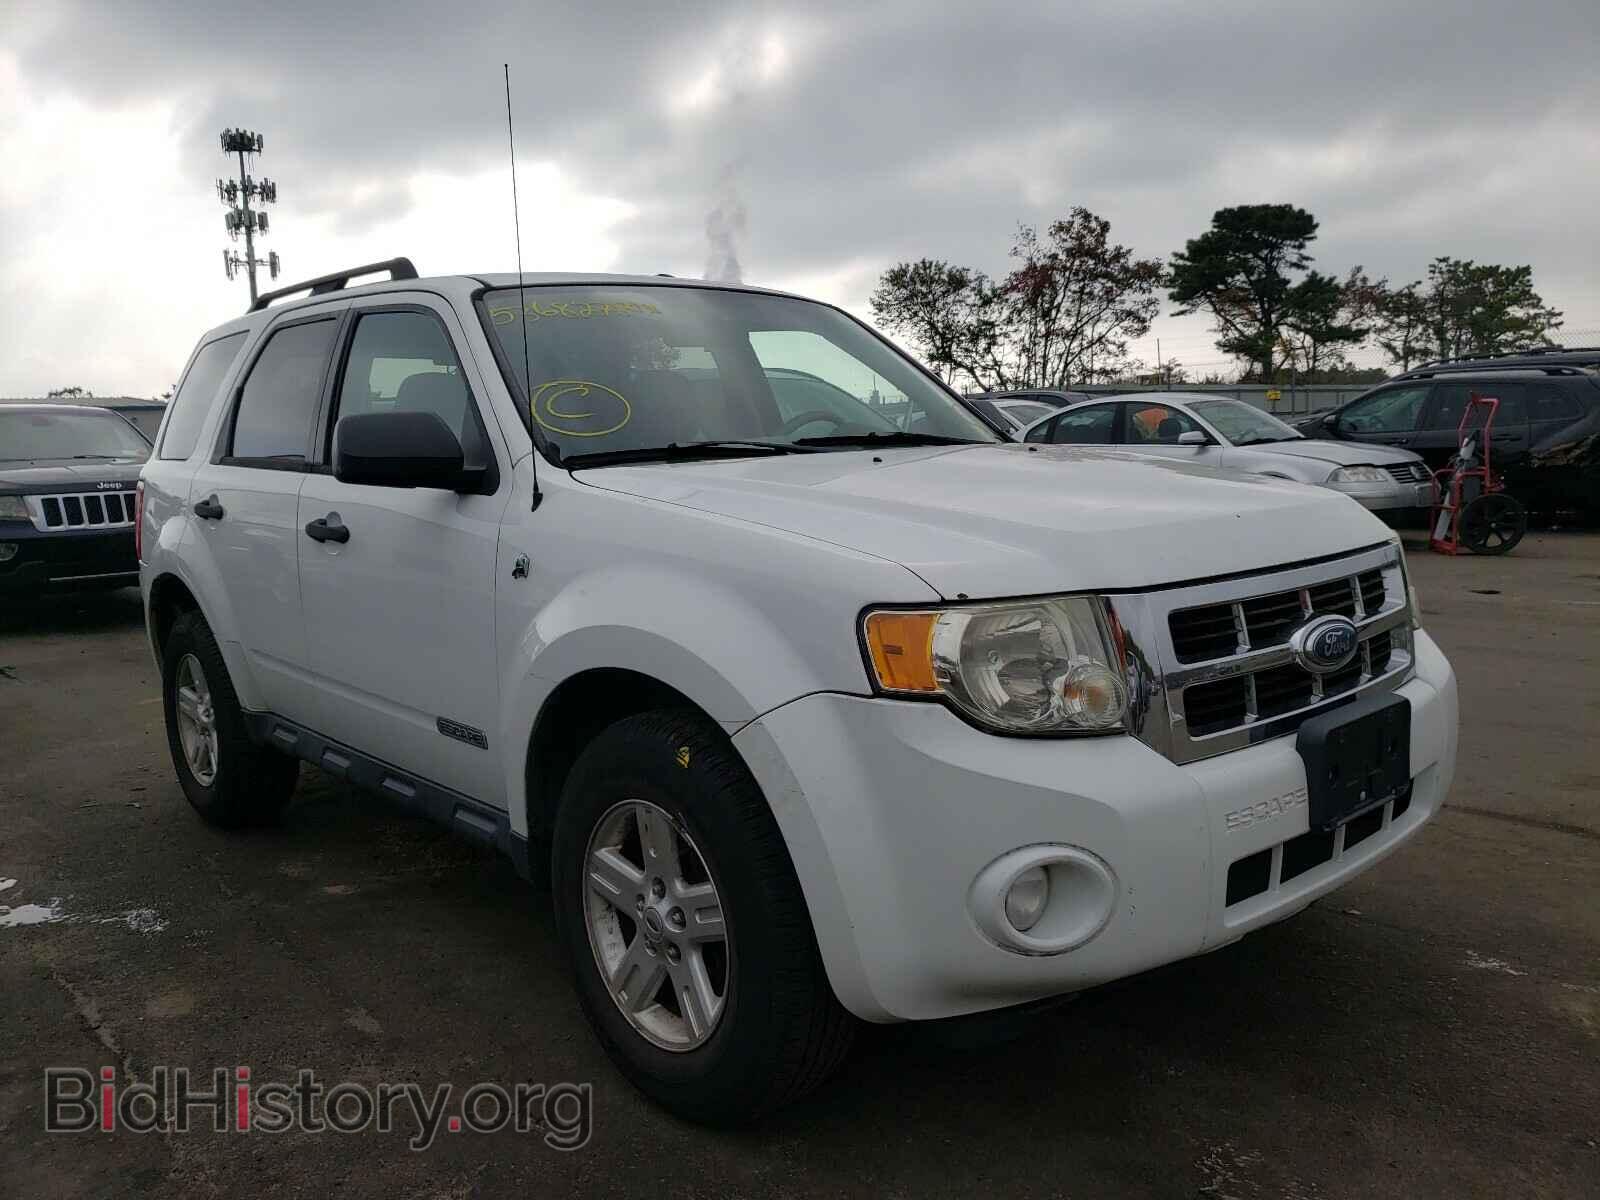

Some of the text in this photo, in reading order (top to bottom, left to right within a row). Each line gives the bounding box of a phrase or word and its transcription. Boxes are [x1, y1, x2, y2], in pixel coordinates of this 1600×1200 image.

[97, 481, 122, 489] Jeep
[1324, 630, 1350, 656] Ford
[1223, 785, 1307, 828] ESCAPE
